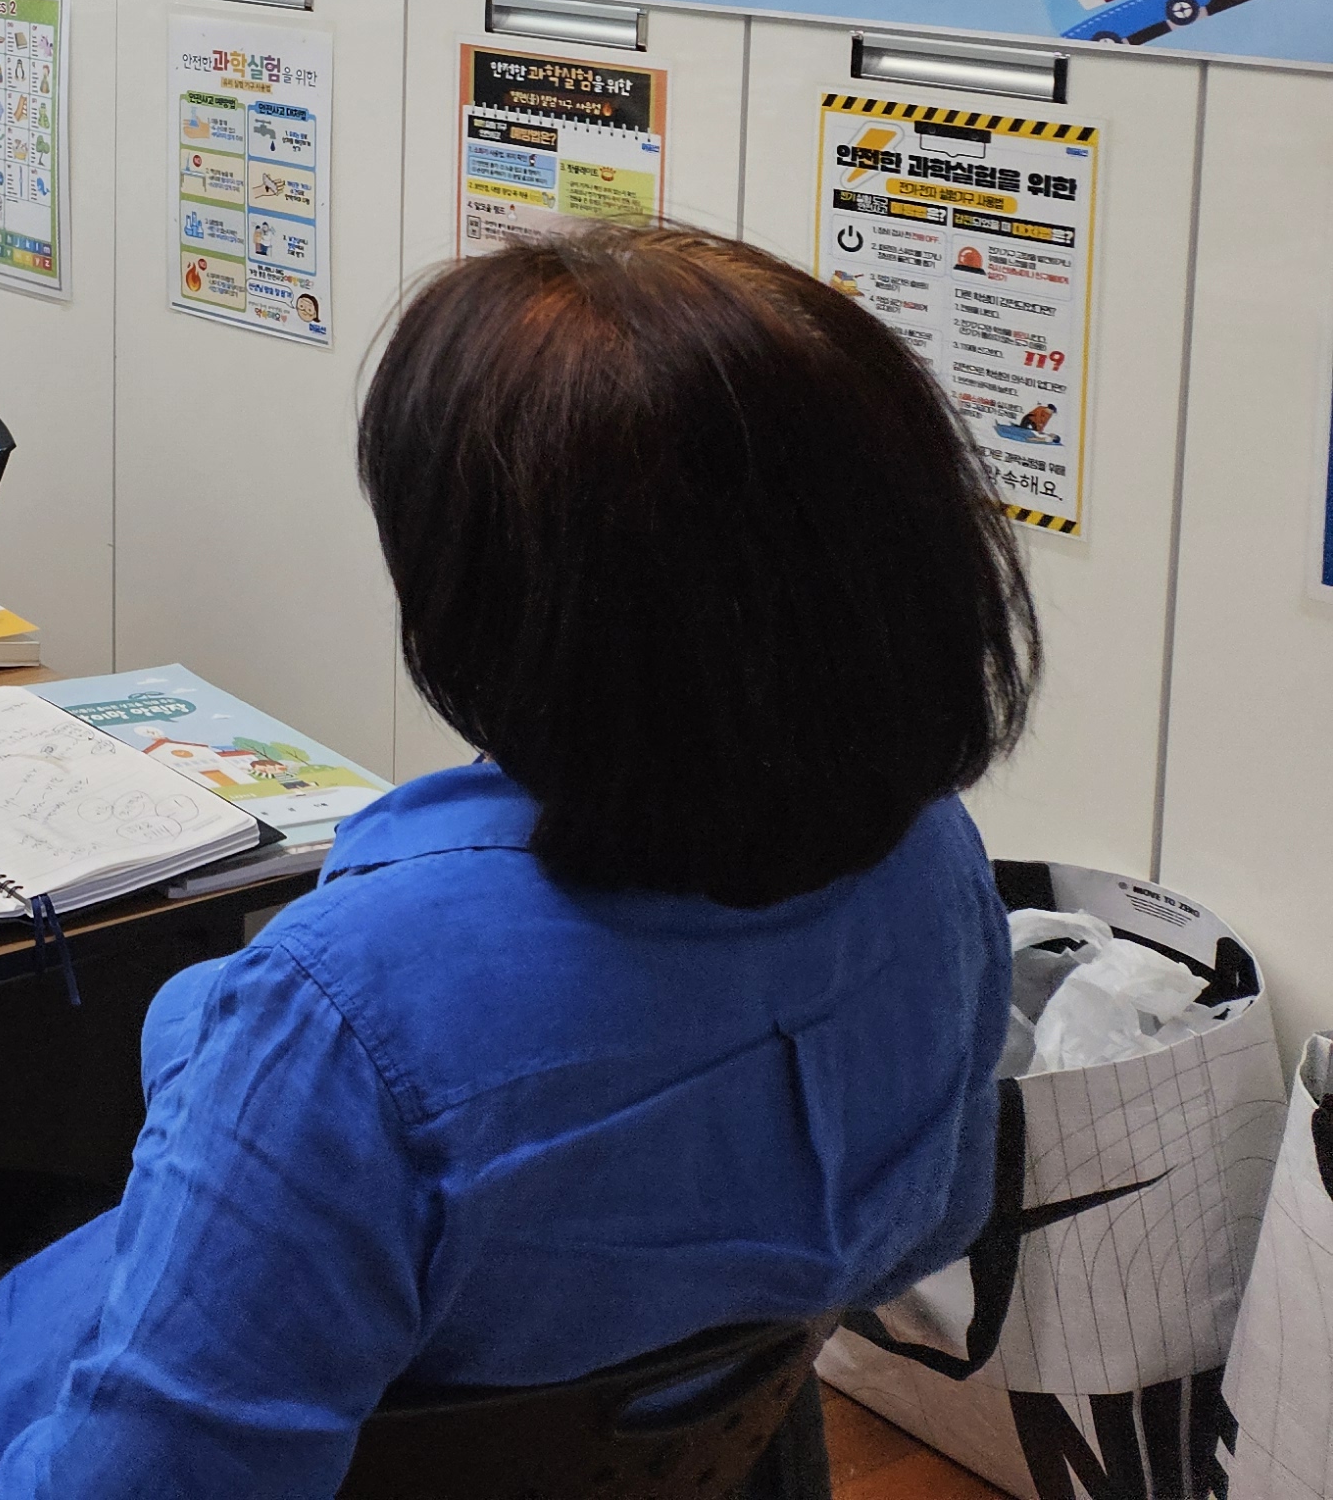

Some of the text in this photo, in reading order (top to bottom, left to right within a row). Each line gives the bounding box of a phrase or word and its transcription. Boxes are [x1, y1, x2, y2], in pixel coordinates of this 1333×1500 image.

[10, 1, 16, 14] 2
[183, 52, 212, 72] 안전한
[295, 69, 317, 87] 위한
[490, 62, 527, 81] 안전한
[606, 79, 633, 96] 위한
[576, 101, 602, 115] 사용법
[837, 144, 1077, 201] 안전한 과학실험을 위한
[977, 195, 1005, 211] 사용법
[1024, 350, 1065, 371] 119
[1133, 886, 1200, 918] MOVE TO ZERO
